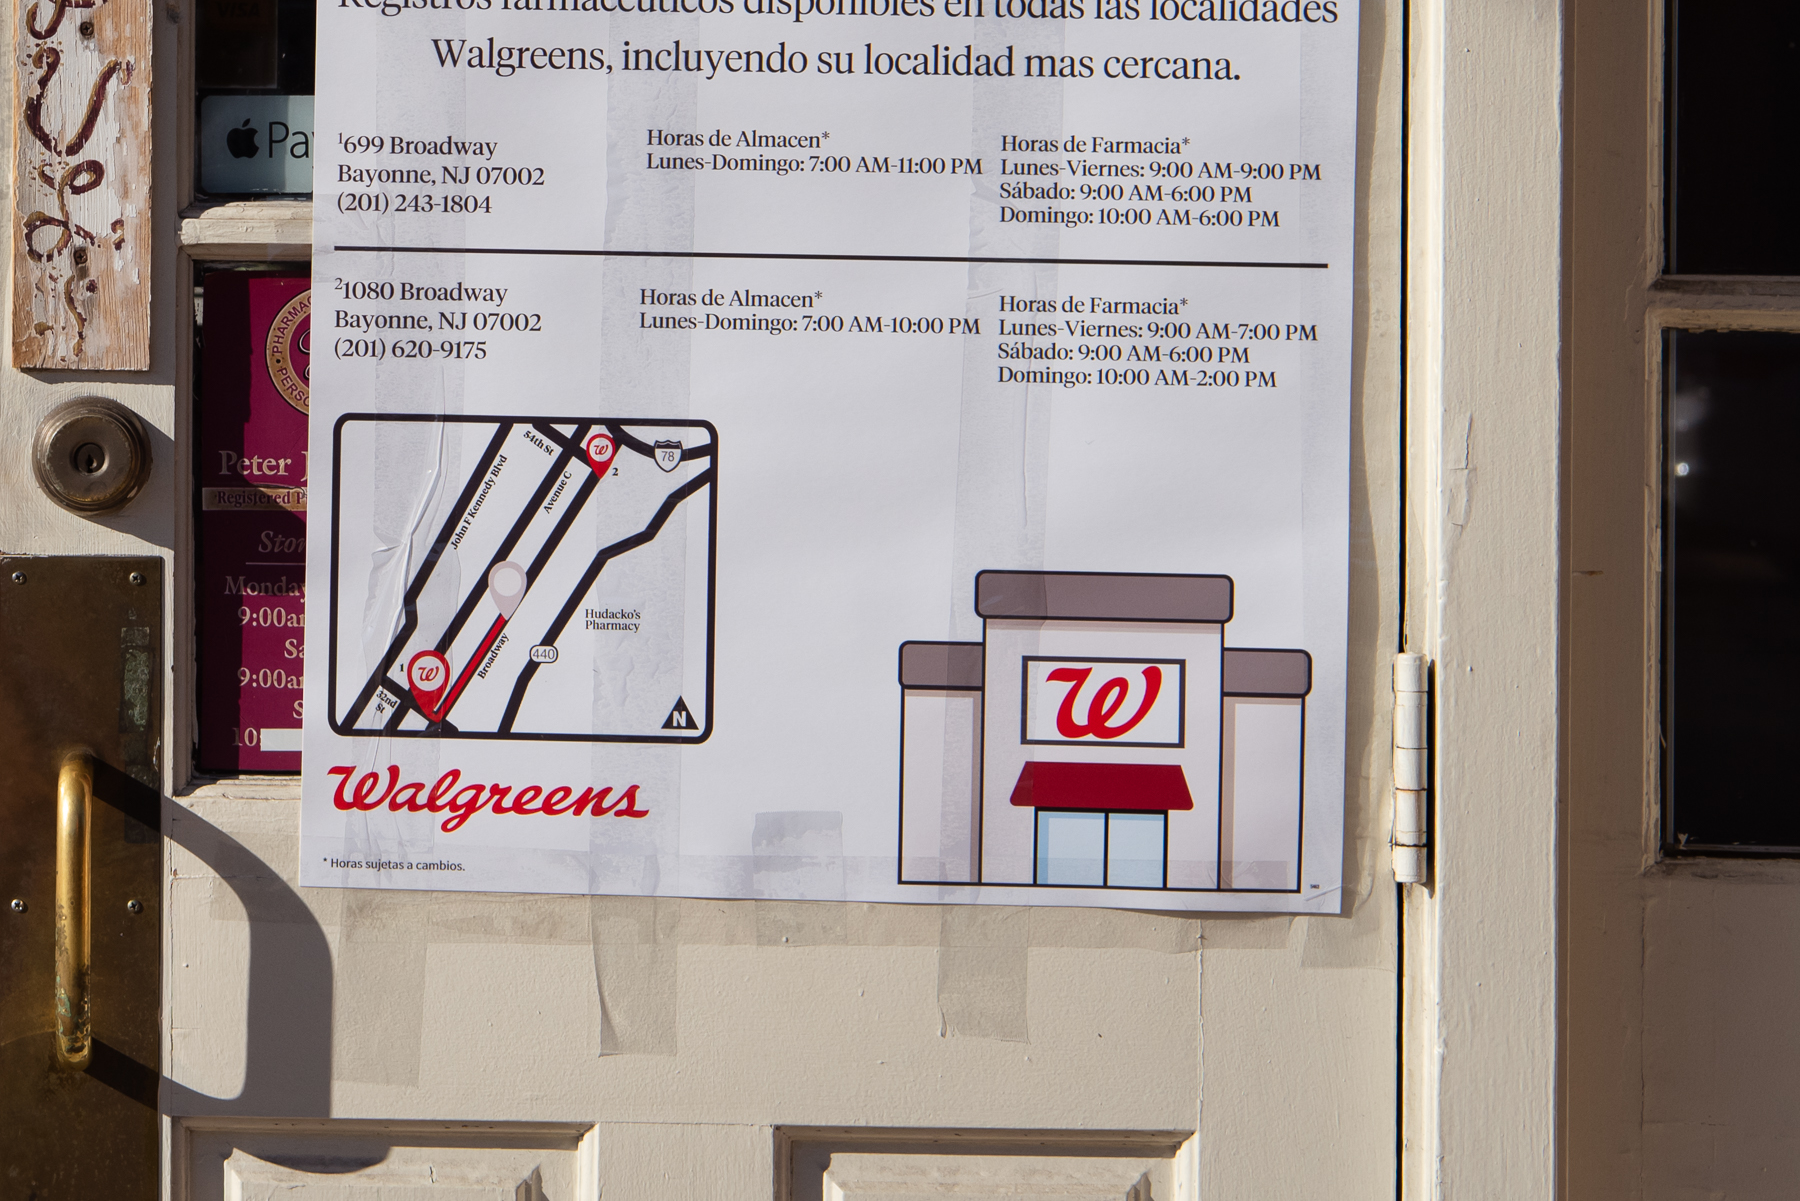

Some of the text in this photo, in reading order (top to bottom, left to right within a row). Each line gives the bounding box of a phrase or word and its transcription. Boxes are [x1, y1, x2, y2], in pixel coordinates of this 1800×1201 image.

[216, 2, 261, 17] VISA
[431, 37, 1241, 80] Walgreens, incluyendo su localidad mas cercana.
[269, 121, 314, 169] Pa
[390, 136, 497, 160] Broadway
[647, 129, 704, 146] Horas
[709, 129, 731, 146] de
[1001, 135, 1059, 152] Horas
[1064, 135, 1087, 152] de
[647, 153, 983, 176] Lunes-Domingo: 7:00 AM-11:00 PM
[1001, 159, 1321, 180] Lunes-Viernes: 9:00 AM-9:00 PM
[338, 165, 544, 187] Bayonne, NJ 07002
[1000, 182, 1252, 202] Sábado: 9:00 AM-6:00 PM
[338, 192, 492, 215] (201) 243-1804
[1000, 206, 1280, 228] Domingo: 10:00 AM-6:00 PM
[218, 450, 292, 476] Peter
[217, 491, 291, 507] Registered
[585, 609, 641, 619] Hudacko's
[586, 620, 640, 633] Pharmacy
[327, 764, 649, 833] Walgreens
[331, 858, 362, 868] Horas
[366, 859, 404, 872] sujetas
[416, 860, 465, 871] cambios.
